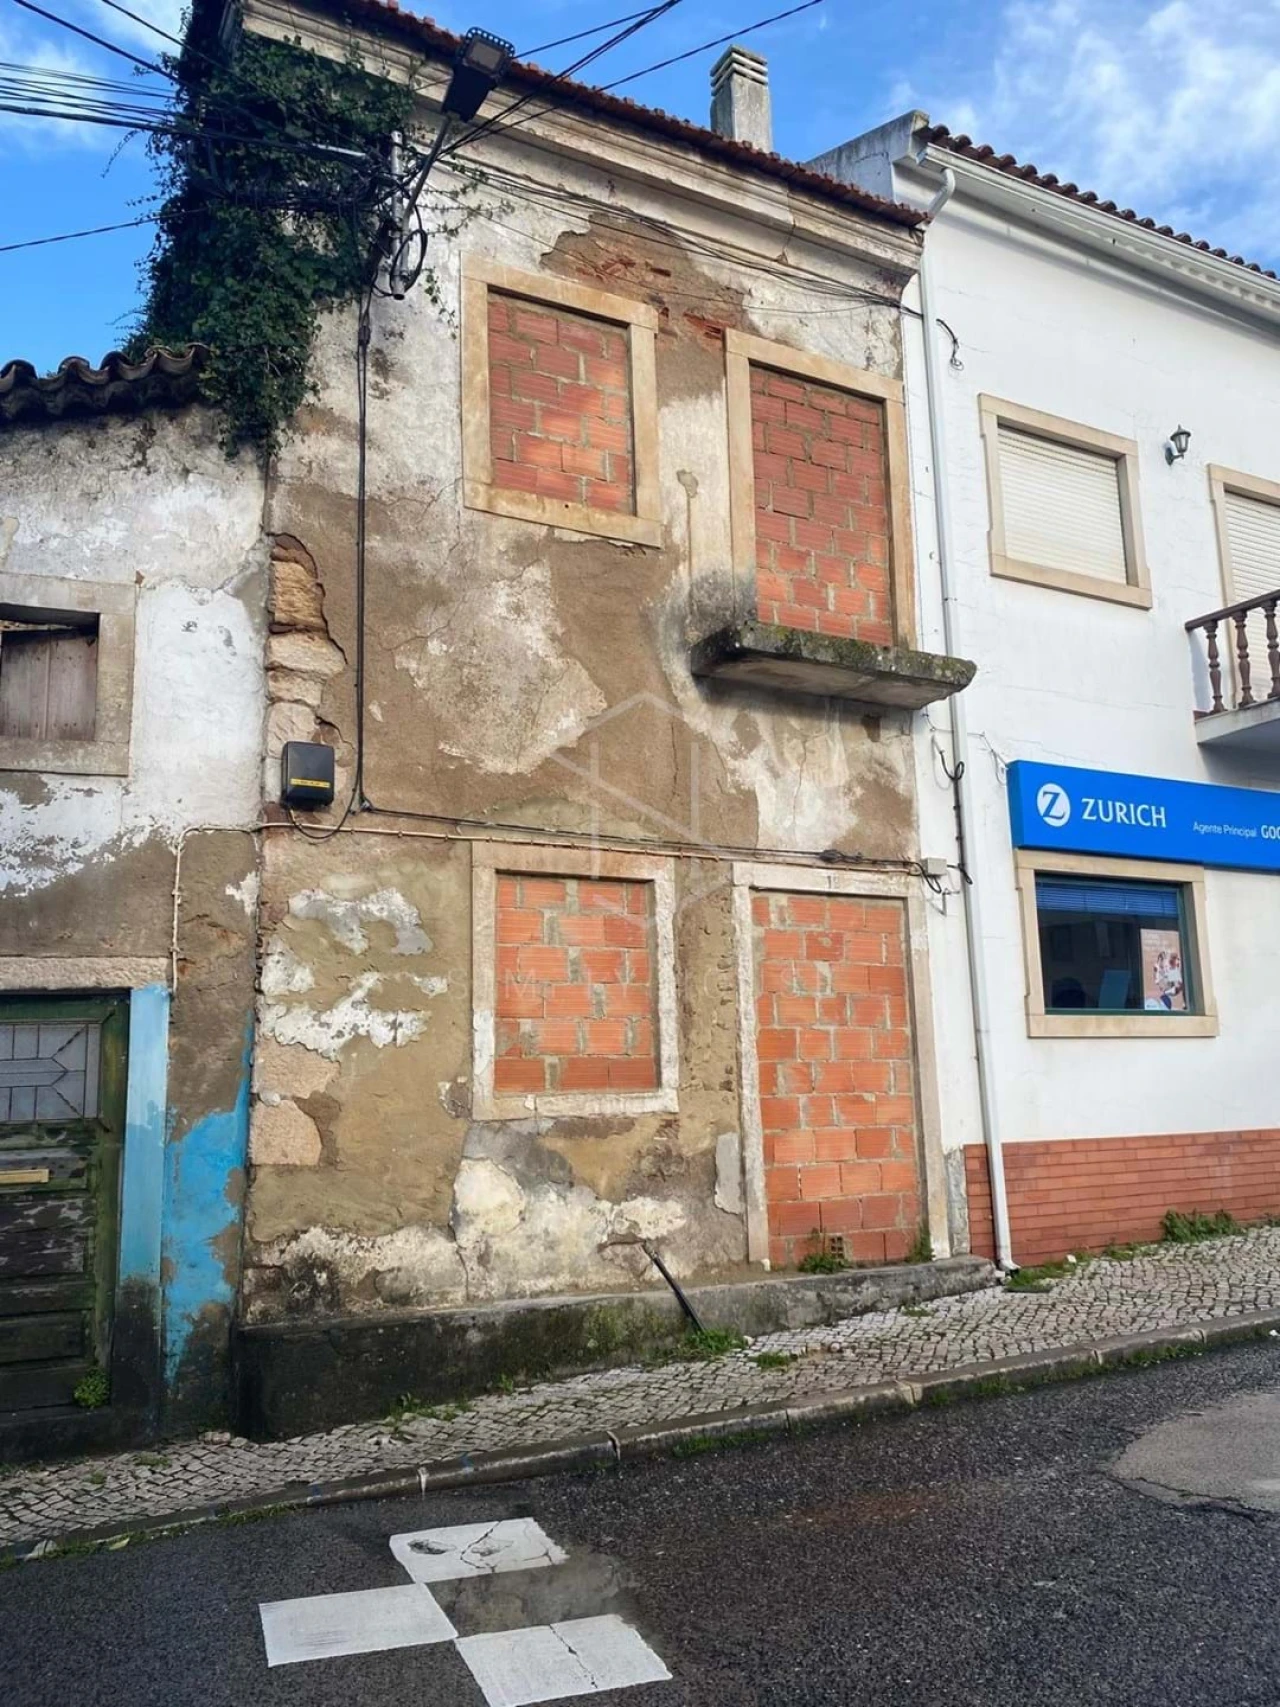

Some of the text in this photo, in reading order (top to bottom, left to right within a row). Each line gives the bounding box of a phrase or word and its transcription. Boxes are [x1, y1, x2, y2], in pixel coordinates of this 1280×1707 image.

[1042, 791, 1167, 828] Z ZURICH
[1193, 821, 1222, 834] Agente
[1223, 824, 1257, 838] Principal
